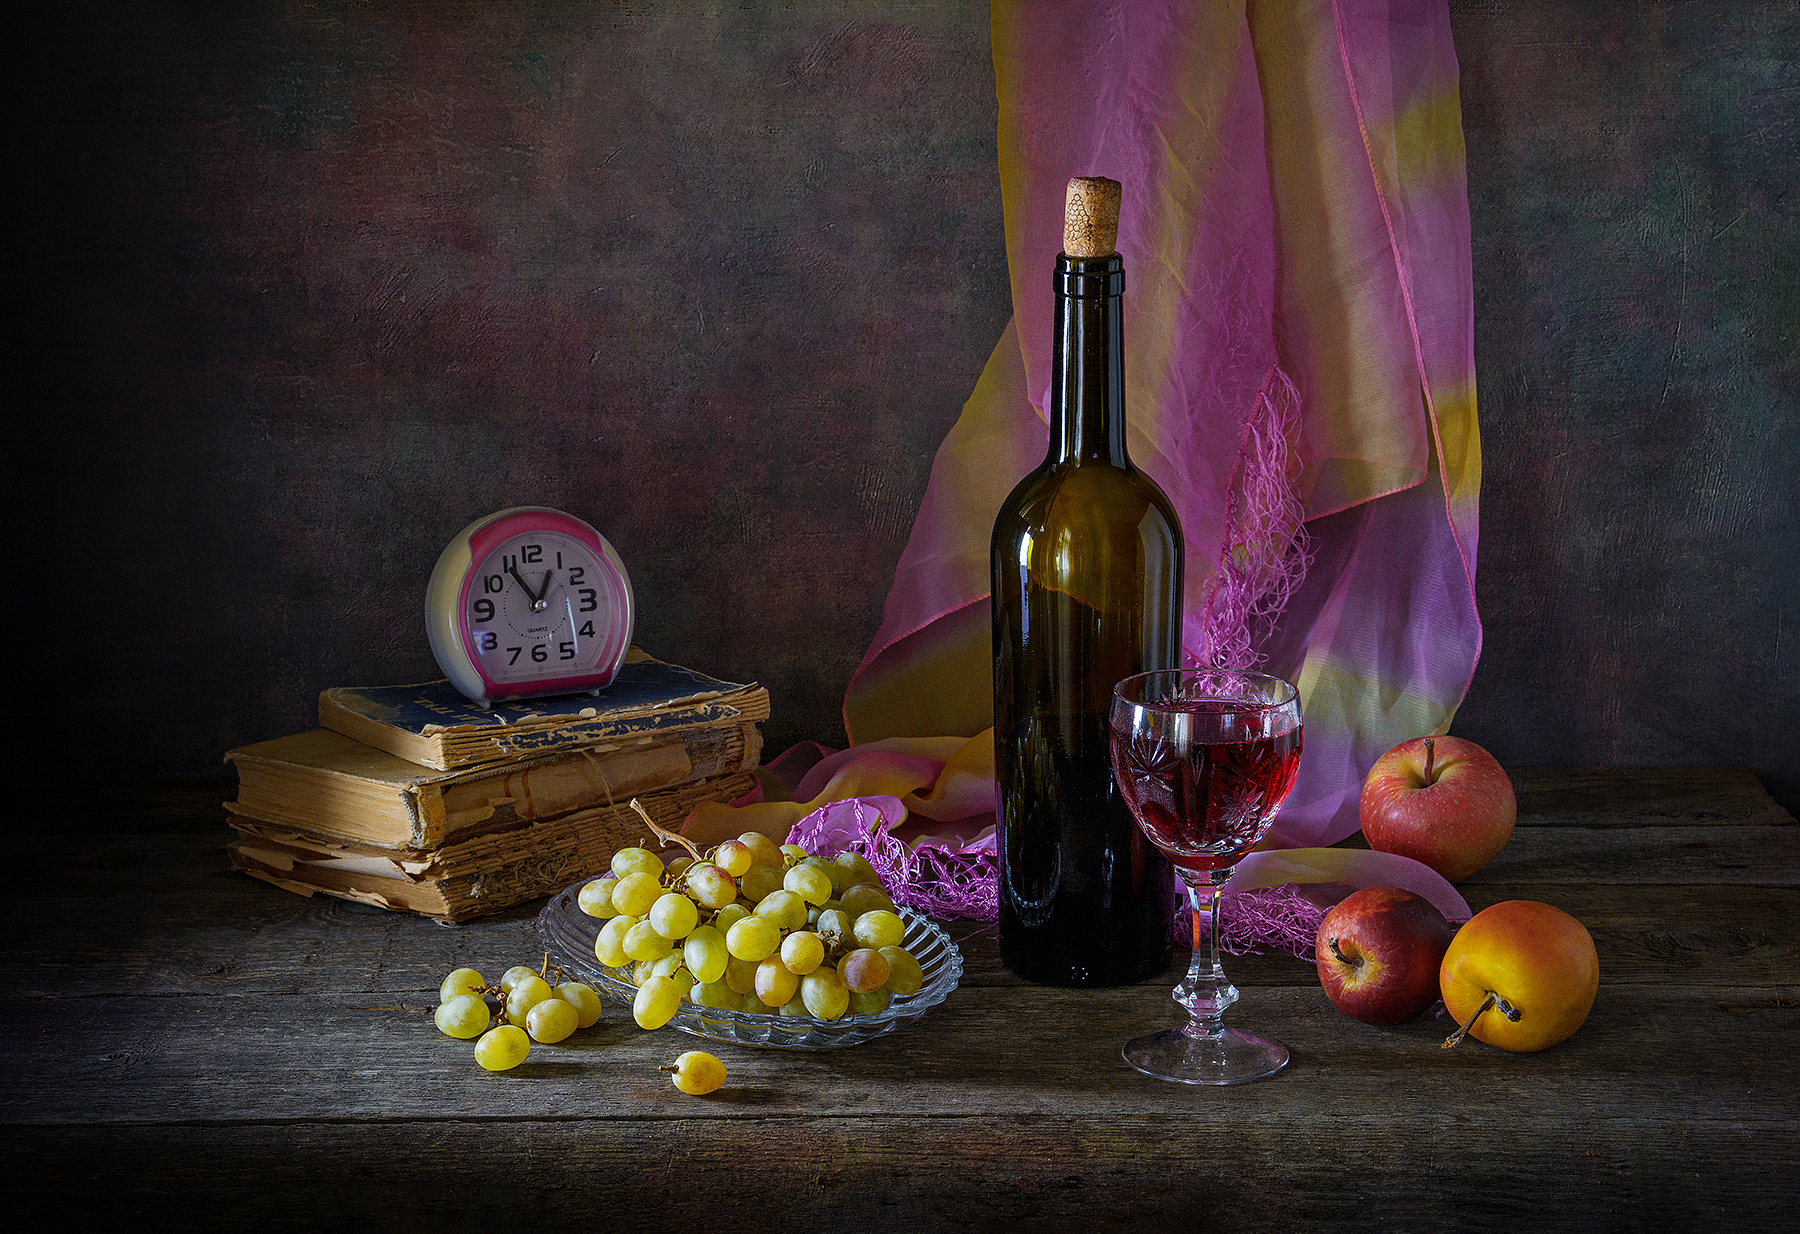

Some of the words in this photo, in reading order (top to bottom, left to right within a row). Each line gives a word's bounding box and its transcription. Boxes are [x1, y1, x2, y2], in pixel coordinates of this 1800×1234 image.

[521, 545, 543, 563] 12
[557, 552, 562, 569] 1
[503, 555, 517, 573] 11
[484, 575, 503, 593] 10
[569, 567, 584, 585] 2
[578, 589, 597, 612] 3
[474, 599, 495, 622] 9
[579, 621, 595, 638] 4
[484, 633, 497, 650] 8
[507, 647, 522, 665] 7
[531, 644, 547, 662] 6
[559, 642, 575, 660] 5
